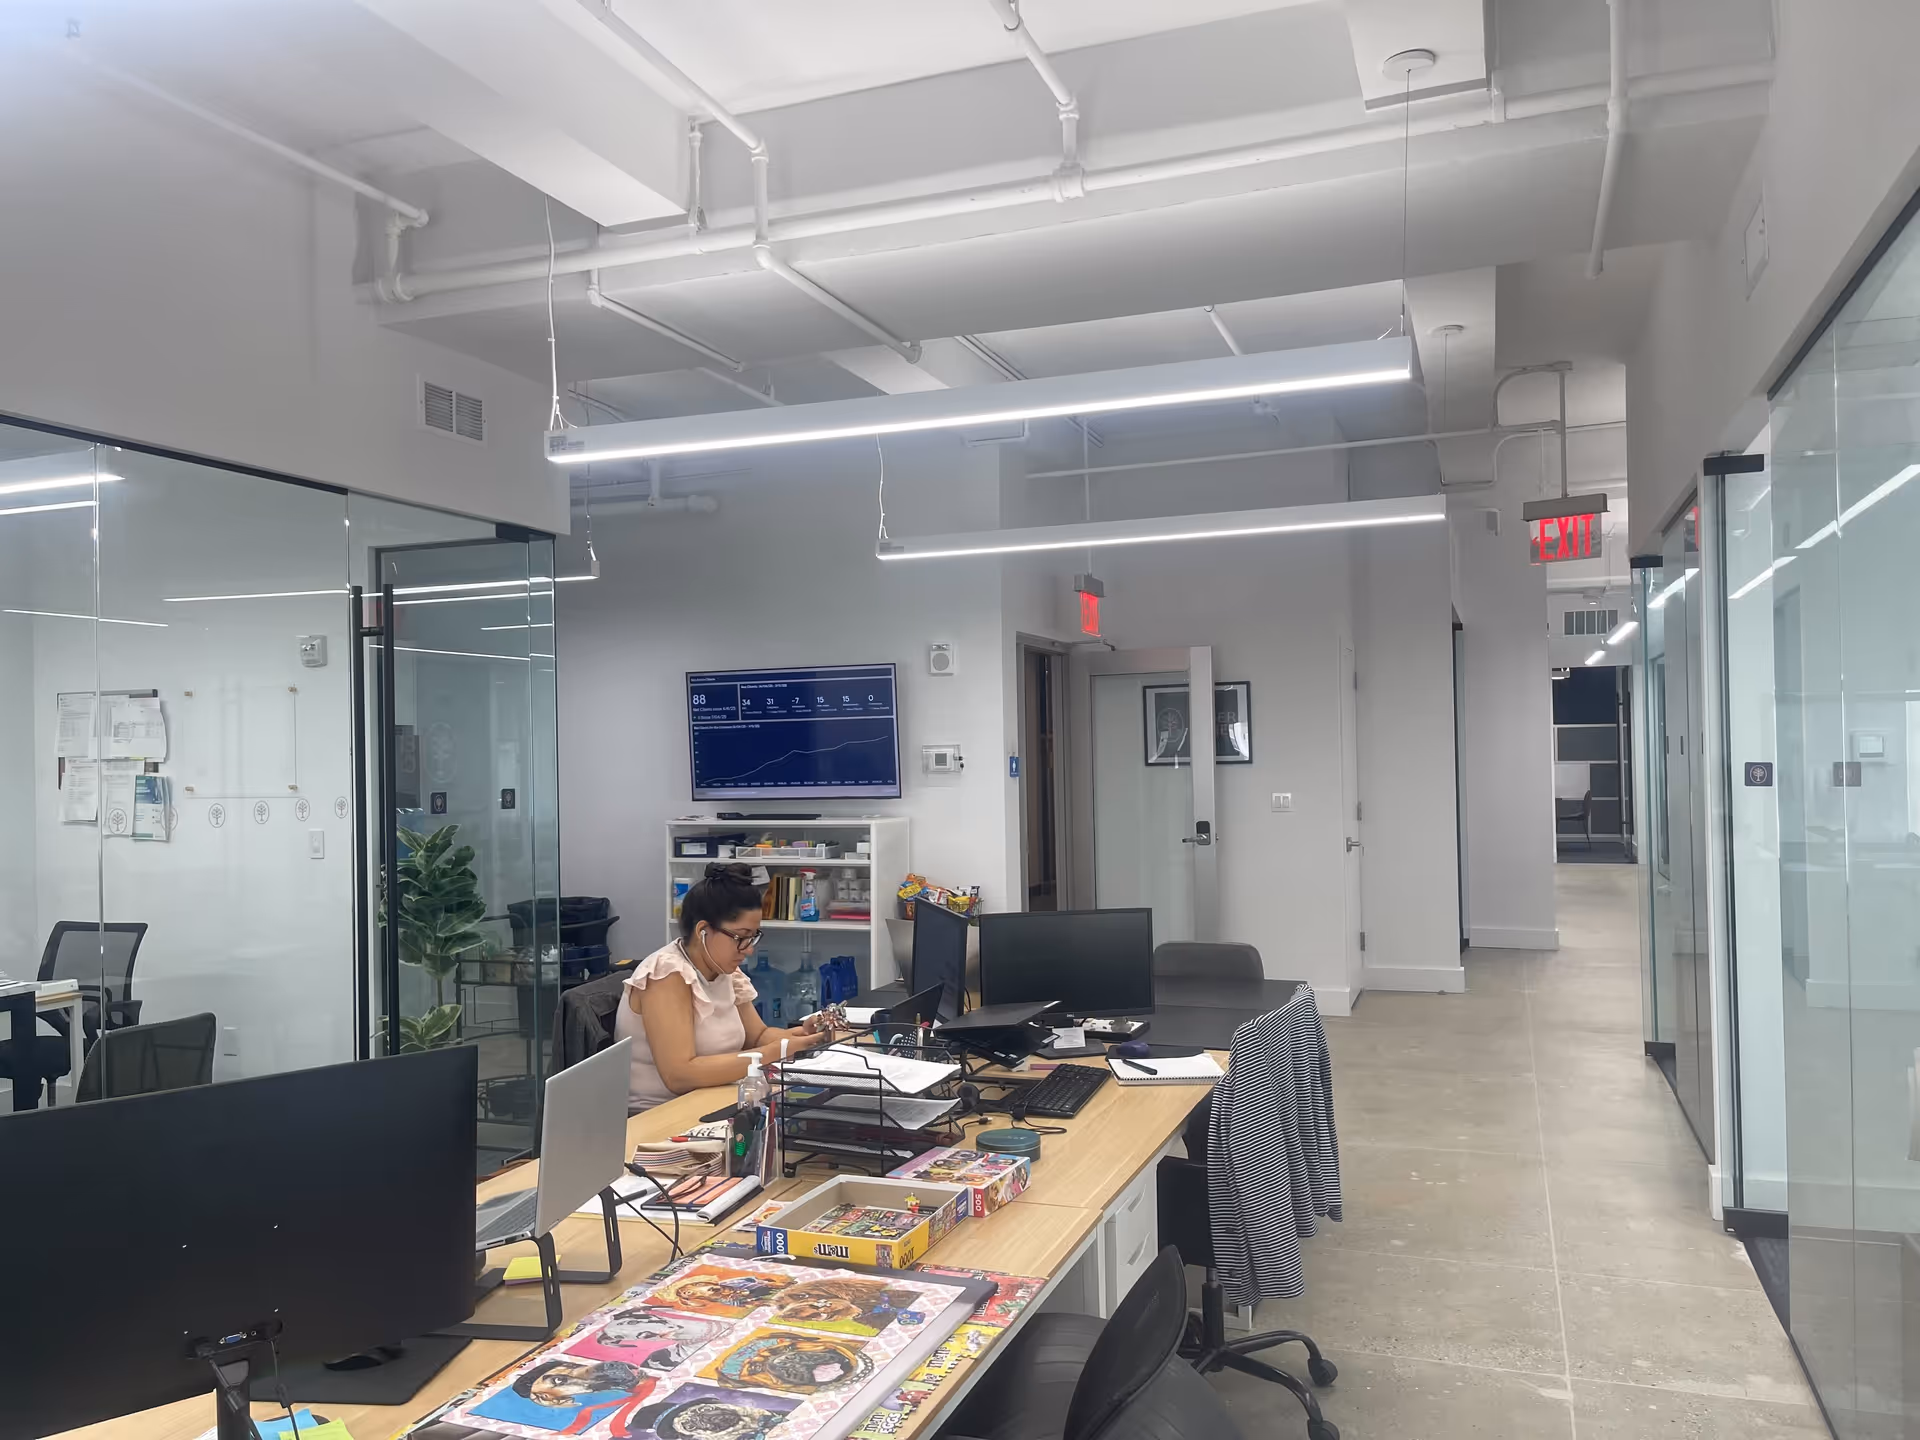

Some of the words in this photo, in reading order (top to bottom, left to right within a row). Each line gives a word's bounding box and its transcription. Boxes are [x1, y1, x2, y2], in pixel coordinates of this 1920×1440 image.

[1539, 513, 1595, 561] EXIT
[692, 694, 706, 705] 88
[868, 694, 874, 702] 0
[974, 1193, 983, 1212] 500
[899, 1246, 915, 1268] 1000
[879, 1412, 903, 1434] EGGS
